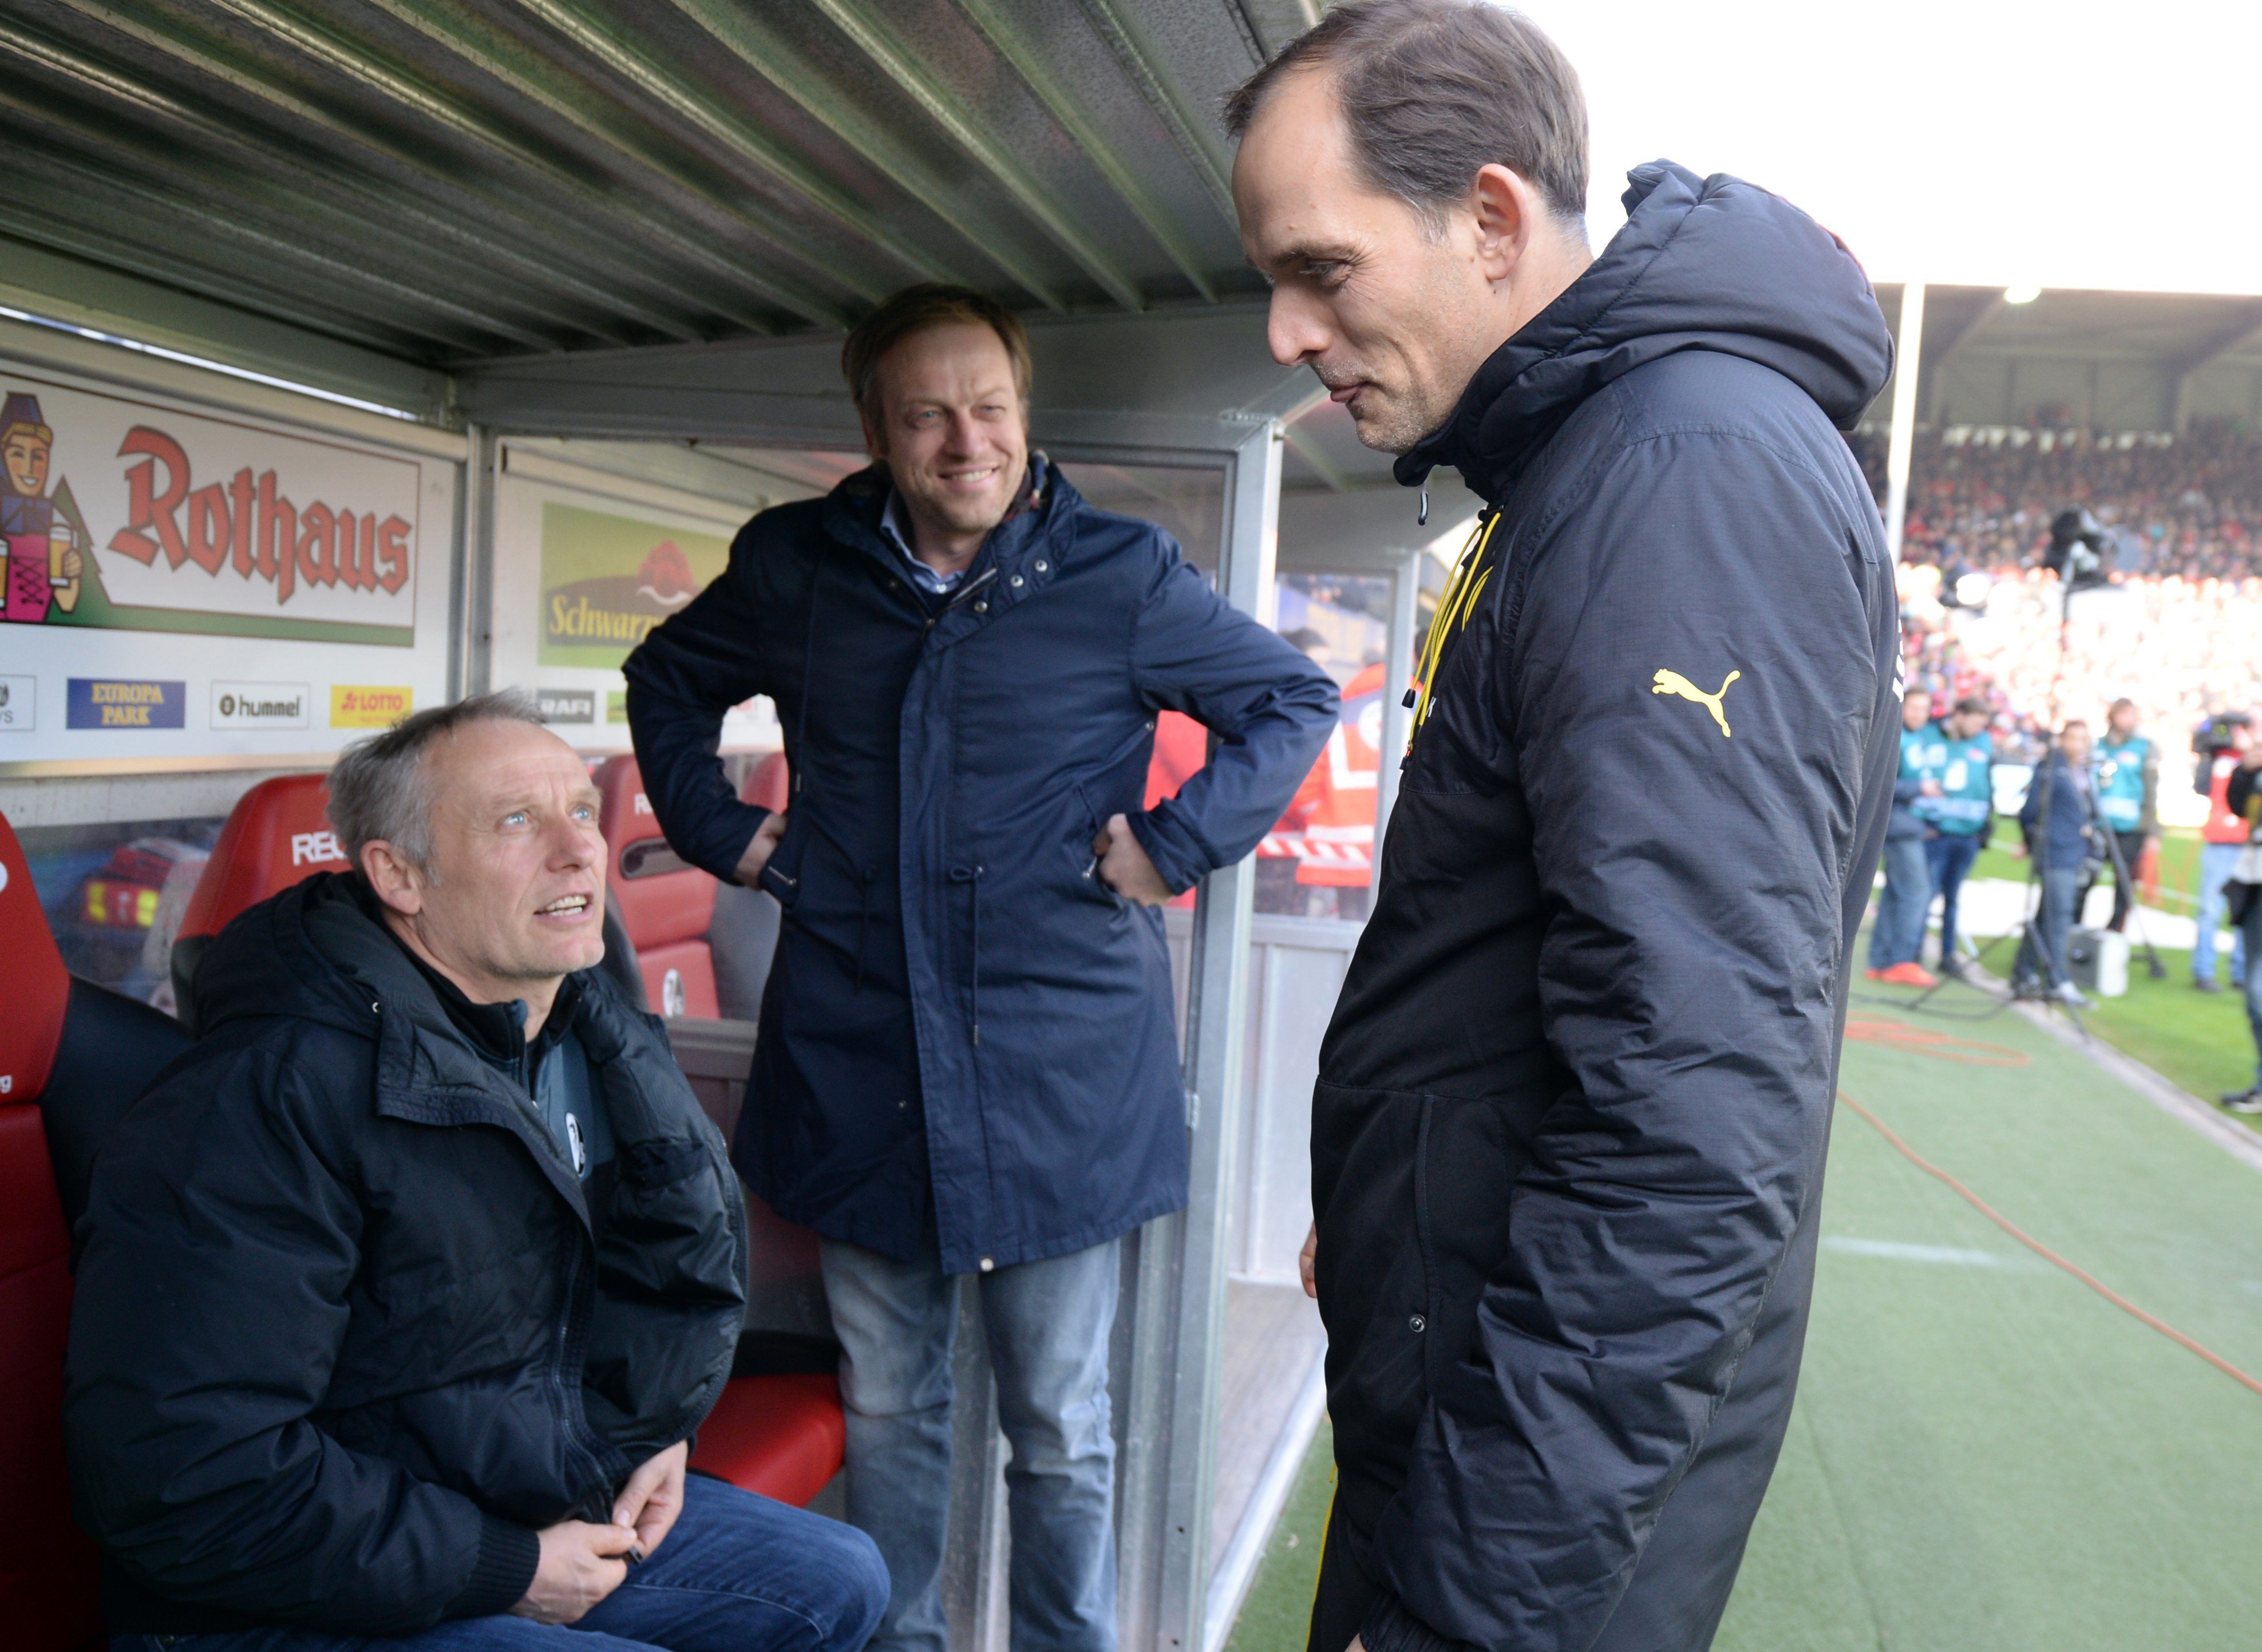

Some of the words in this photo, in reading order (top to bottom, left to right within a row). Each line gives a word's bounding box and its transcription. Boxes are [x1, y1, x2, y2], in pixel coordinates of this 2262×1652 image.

[107, 424, 412, 606] Rothaus
[92, 683, 164, 704] EUROPA
[360, 693, 403, 711] LOTTO
[102, 705, 151, 726] PARK
[239, 693, 300, 717] hummel
